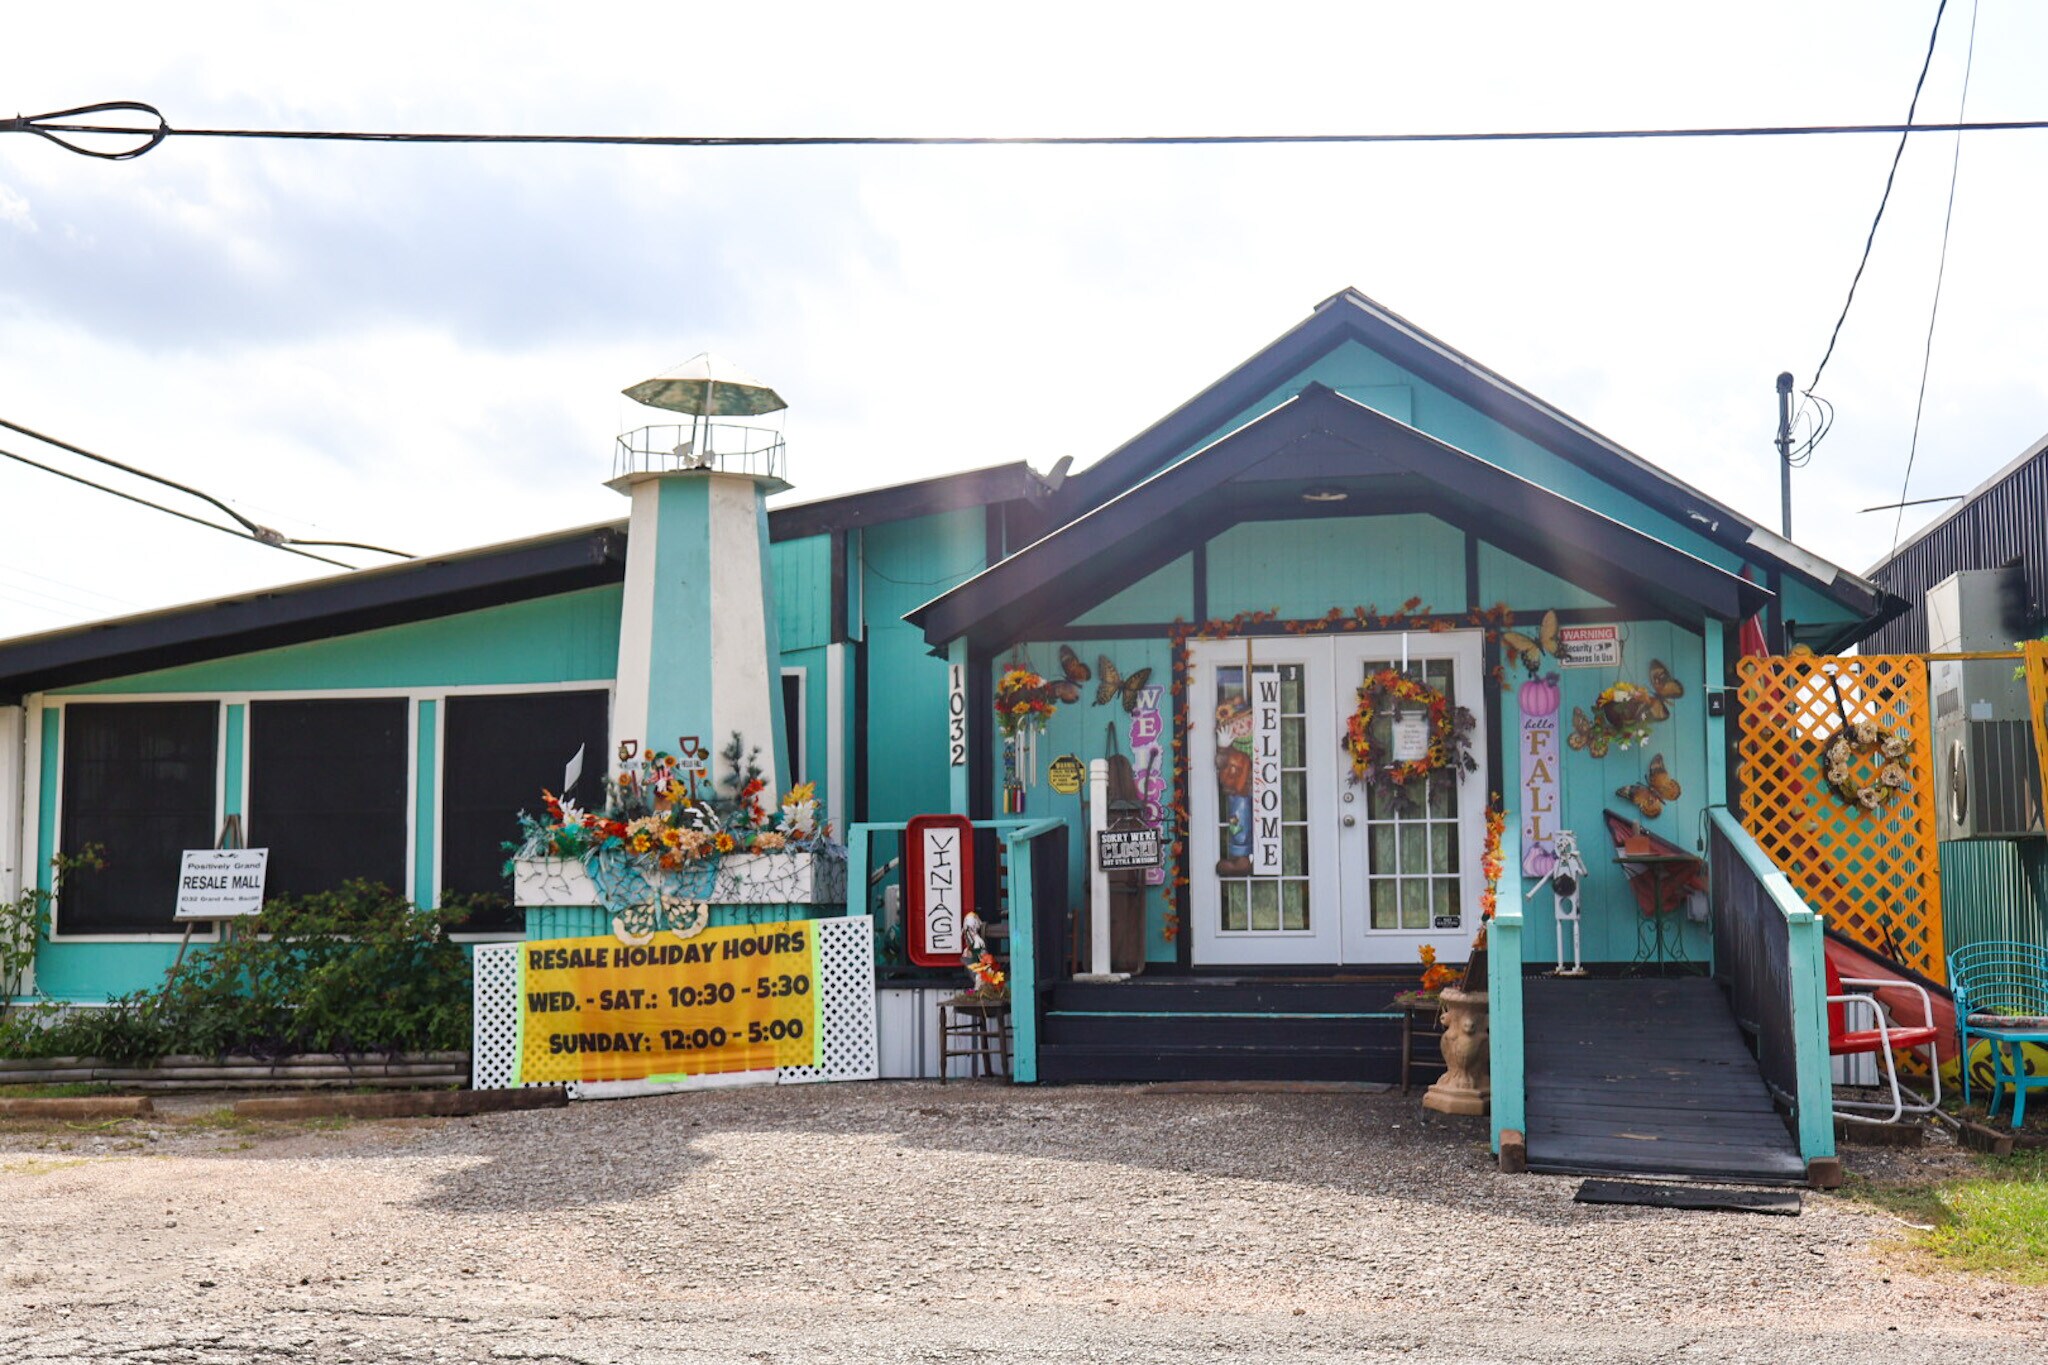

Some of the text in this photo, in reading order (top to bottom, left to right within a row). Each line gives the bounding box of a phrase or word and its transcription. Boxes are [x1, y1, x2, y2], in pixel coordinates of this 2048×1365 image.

[1563, 629, 1613, 640] WARNING
[950, 666, 966, 768] 1032
[1524, 719, 1554, 729] hello
[1260, 681, 1279, 866] WELCOME
[1528, 730, 1553, 841] FALL
[1101, 833, 1128, 843] SORRY
[1101, 841, 1158, 859] CLOSED
[183, 875, 261, 889] RESALE MALL
[928, 834, 954, 949] VINTAGE
[529, 931, 805, 970] RESALE HOLIDAY HOURS
[528, 991, 581, 1013] WED.
[600, 989, 658, 1011] SAT.:
[669, 983, 736, 1007] 10:30
[757, 975, 810, 998] 5:30
[549, 1033, 651, 1054] SUNDAY:
[660, 1027, 727, 1050] 12:00
[748, 1018, 804, 1043] 5:00
